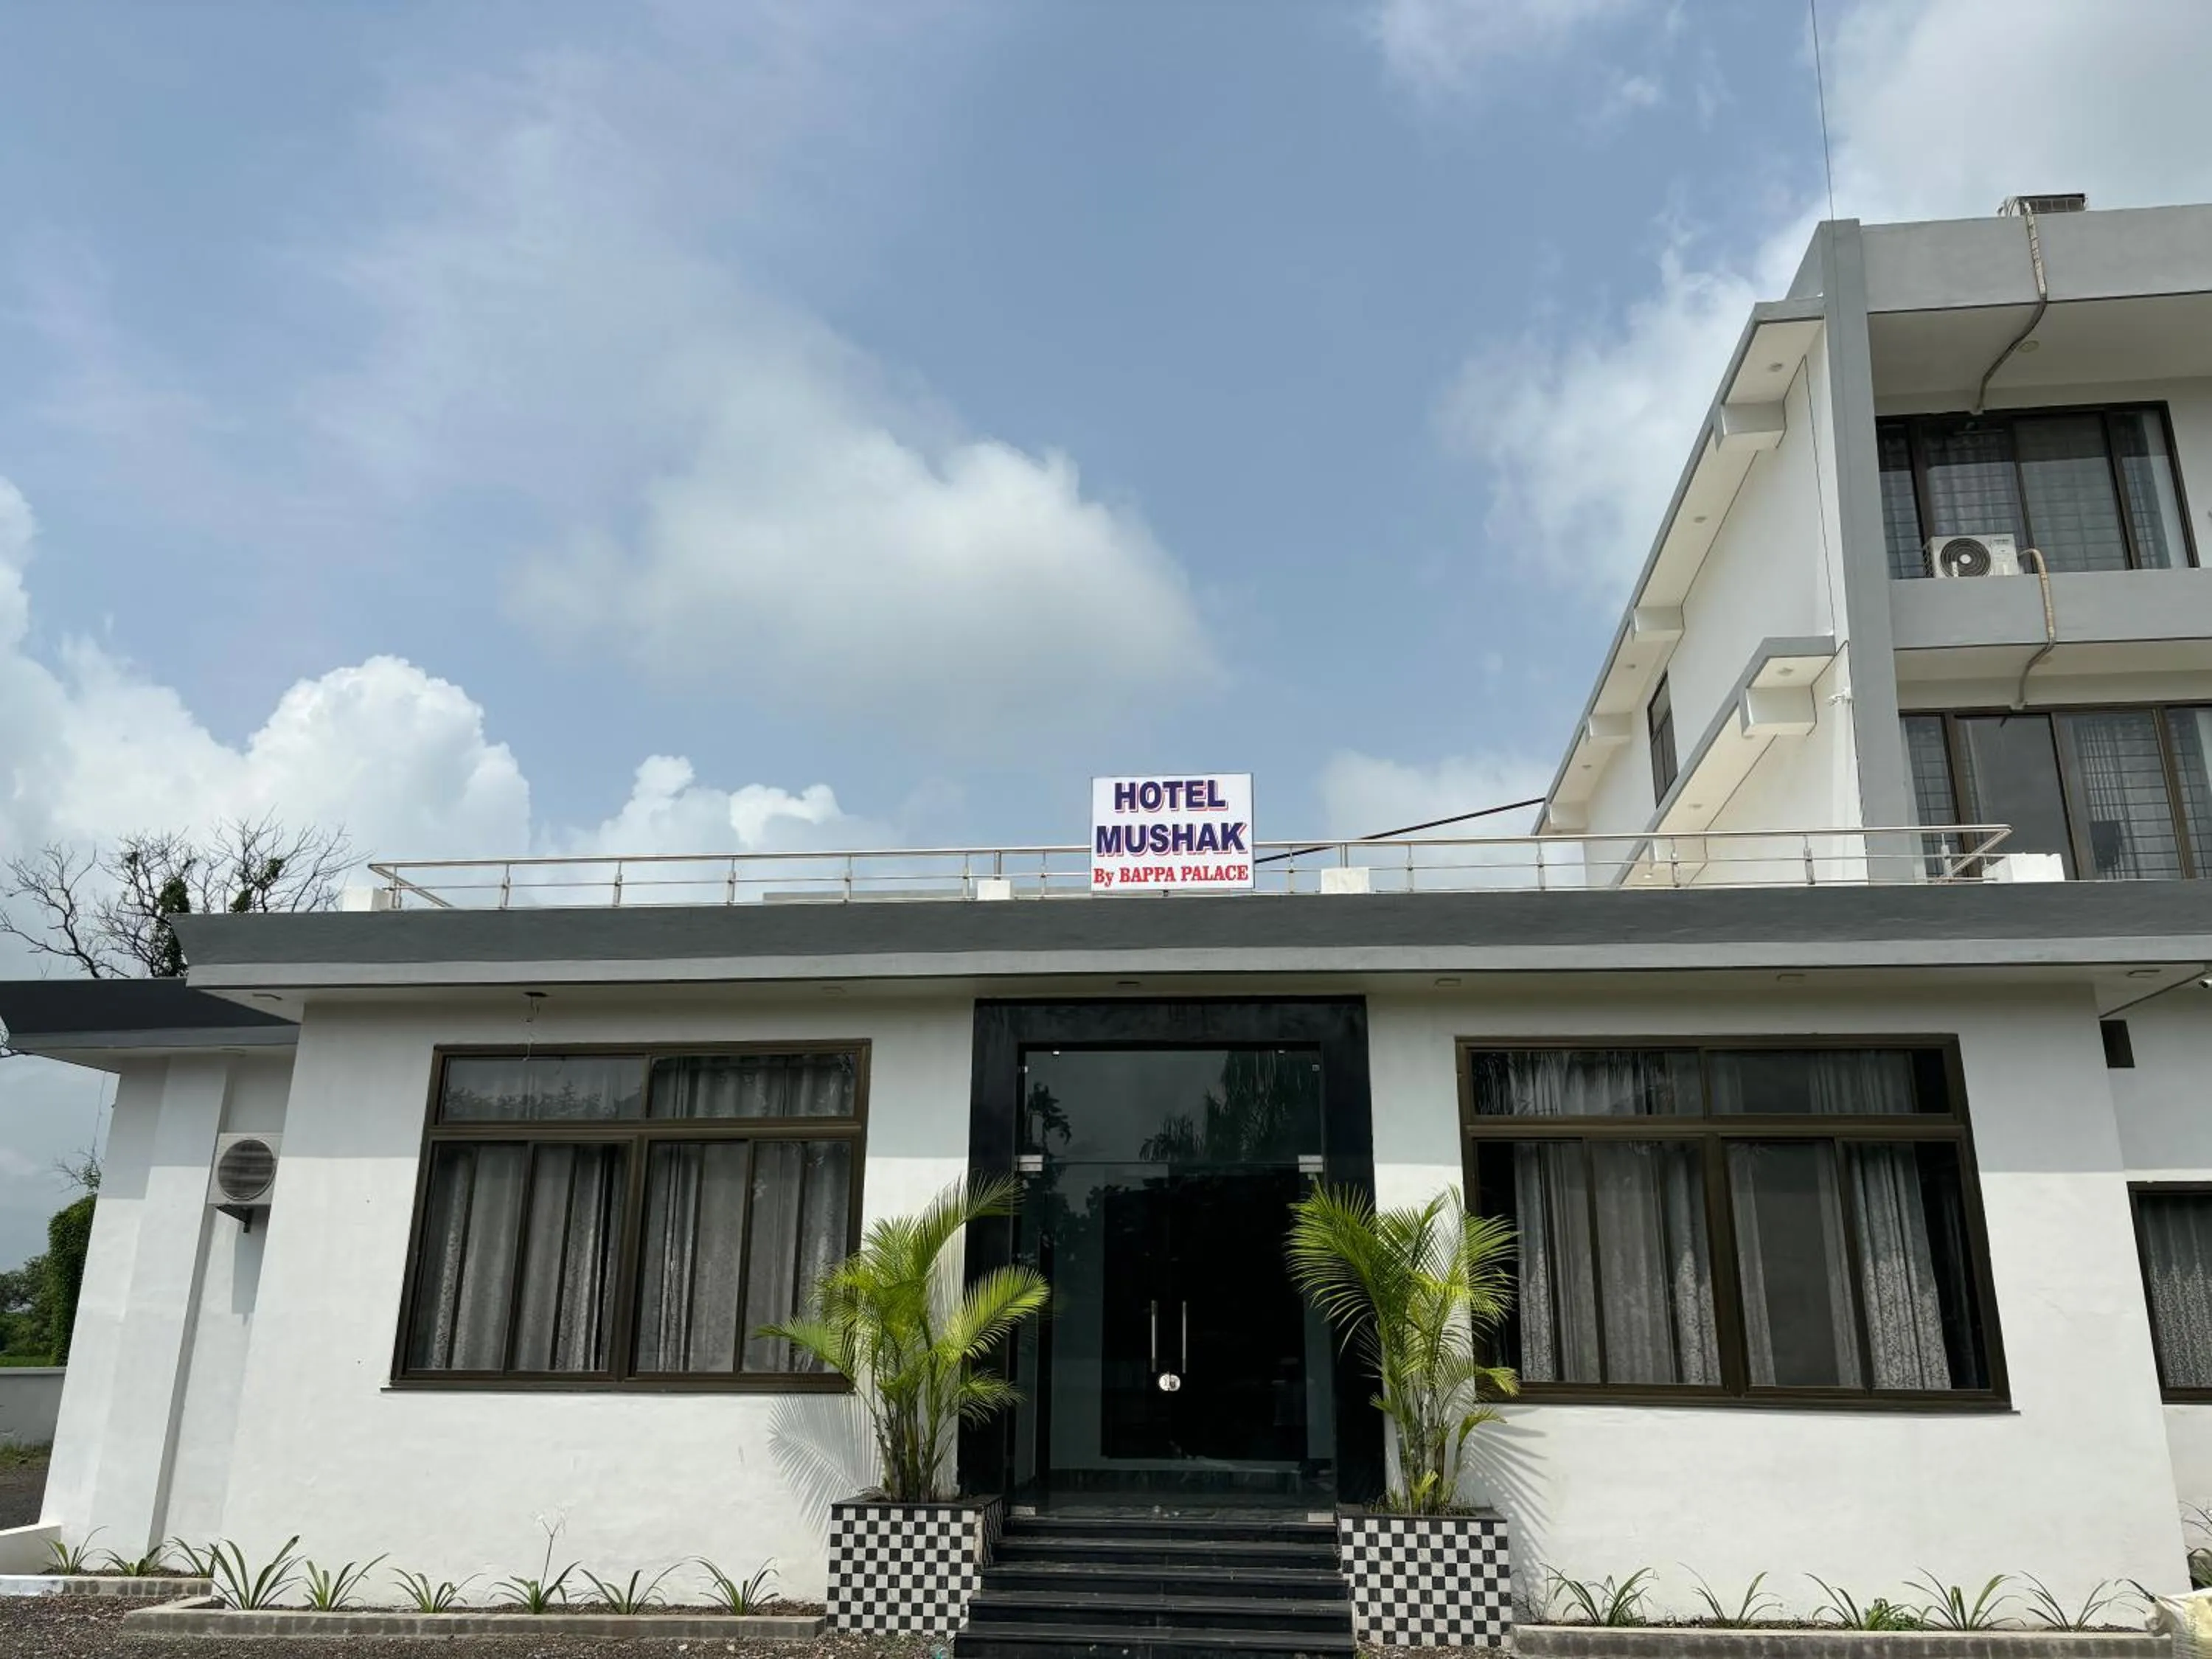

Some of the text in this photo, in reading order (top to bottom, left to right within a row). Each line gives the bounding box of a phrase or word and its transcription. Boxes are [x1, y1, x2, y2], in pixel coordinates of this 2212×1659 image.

[1114, 779, 1228, 813] HOTEL
[1096, 822, 1248, 857] MUSHAK
[1093, 865, 1248, 887] By BAPPA PALACE
